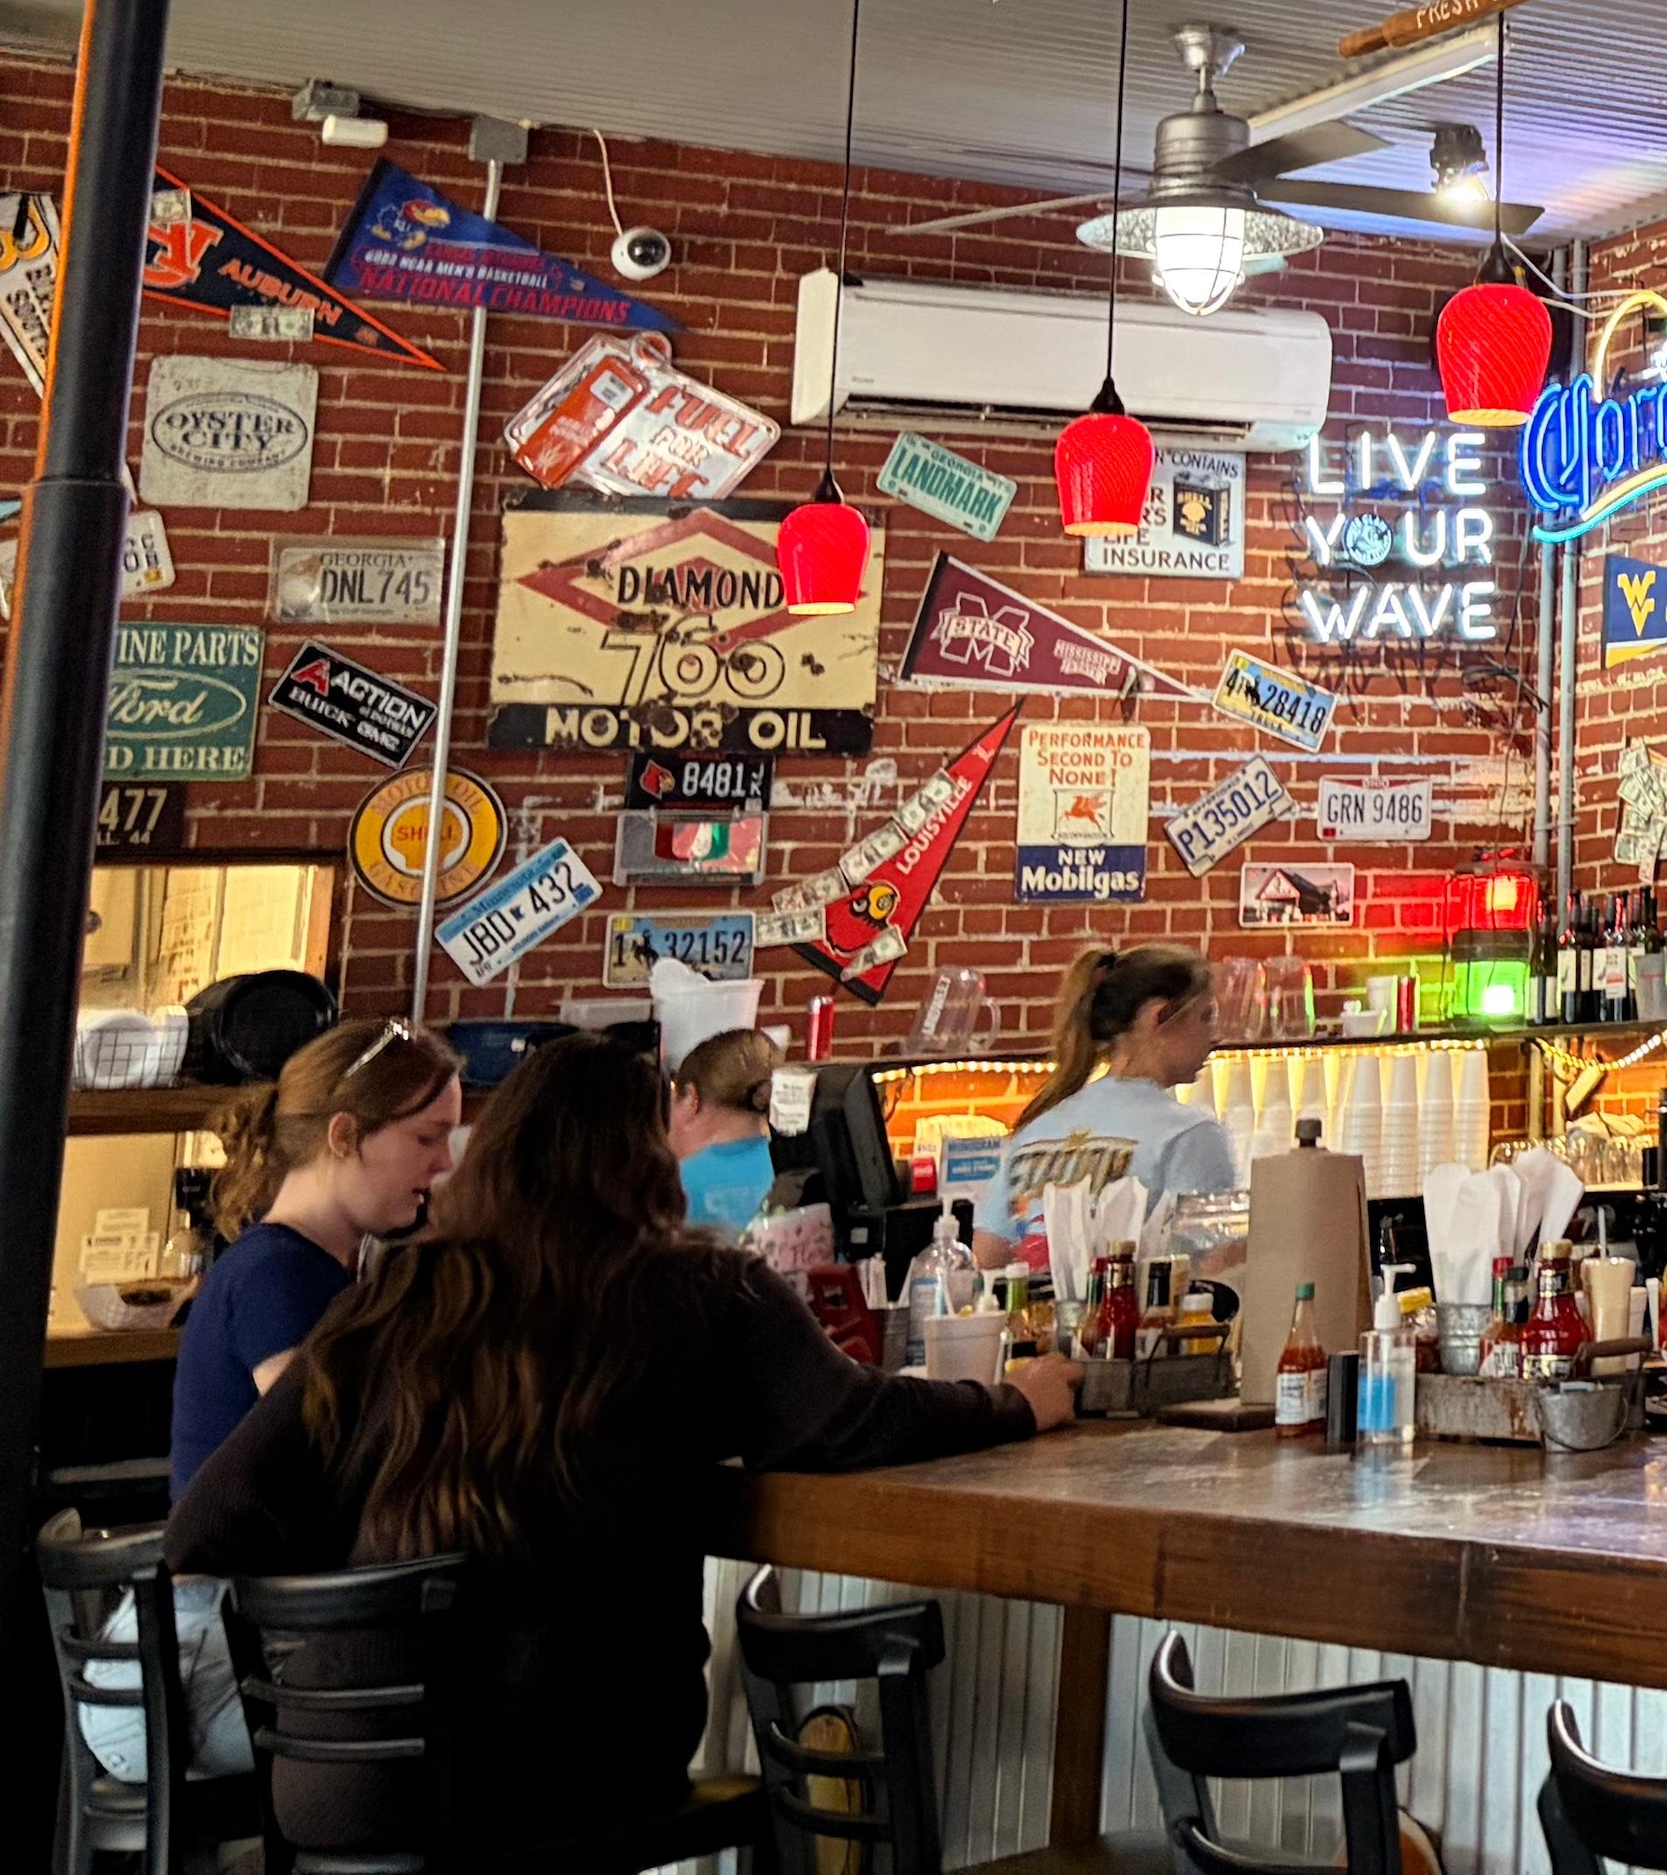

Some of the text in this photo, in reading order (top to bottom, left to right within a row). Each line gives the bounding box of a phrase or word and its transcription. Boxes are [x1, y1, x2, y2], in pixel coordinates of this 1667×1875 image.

[219, 255, 343, 325] AUBURN
[477, 265, 548, 289] BASKETBALL
[361, 266, 631, 324] NATIONAL CHAMPIONS
[166, 411, 295, 435] OYSTER
[182, 429, 274, 451] CITY
[1171, 451, 1239, 479] CONTAINS
[1307, 431, 1489, 497] LIVE
[892, 451, 1004, 524] LANDMARK
[320, 552, 408, 568] GEORGIA
[1102, 547, 1231, 573] INSURANCE
[380, 569, 431, 604] 745
[617, 566, 787, 609] DIAMOND
[1301, 582, 1497, 643] WAVE
[174, 631, 259, 667] PARTS
[289, 688, 357, 732] BUICK
[331, 669, 428, 732] ACTION
[1260, 681, 1328, 735] 28418
[546, 709, 826, 749] MOTOR OIL
[1029, 729, 1145, 750] PERFORMANCE
[142, 746, 247, 773] HERE
[1037, 748, 1133, 768] SECOND TO
[682, 762, 746, 797] 8481
[1049, 767, 1117, 786] NONE!
[896, 774, 972, 875] LOUISVILLE
[1178, 769, 1280, 864] P135012
[1326, 790, 1424, 825] GRN 9486
[1058, 849, 1105, 866] NEW
[530, 861, 584, 915] 432
[1022, 865, 1140, 900] Mobilgas
[664, 929, 745, 965] 32152
